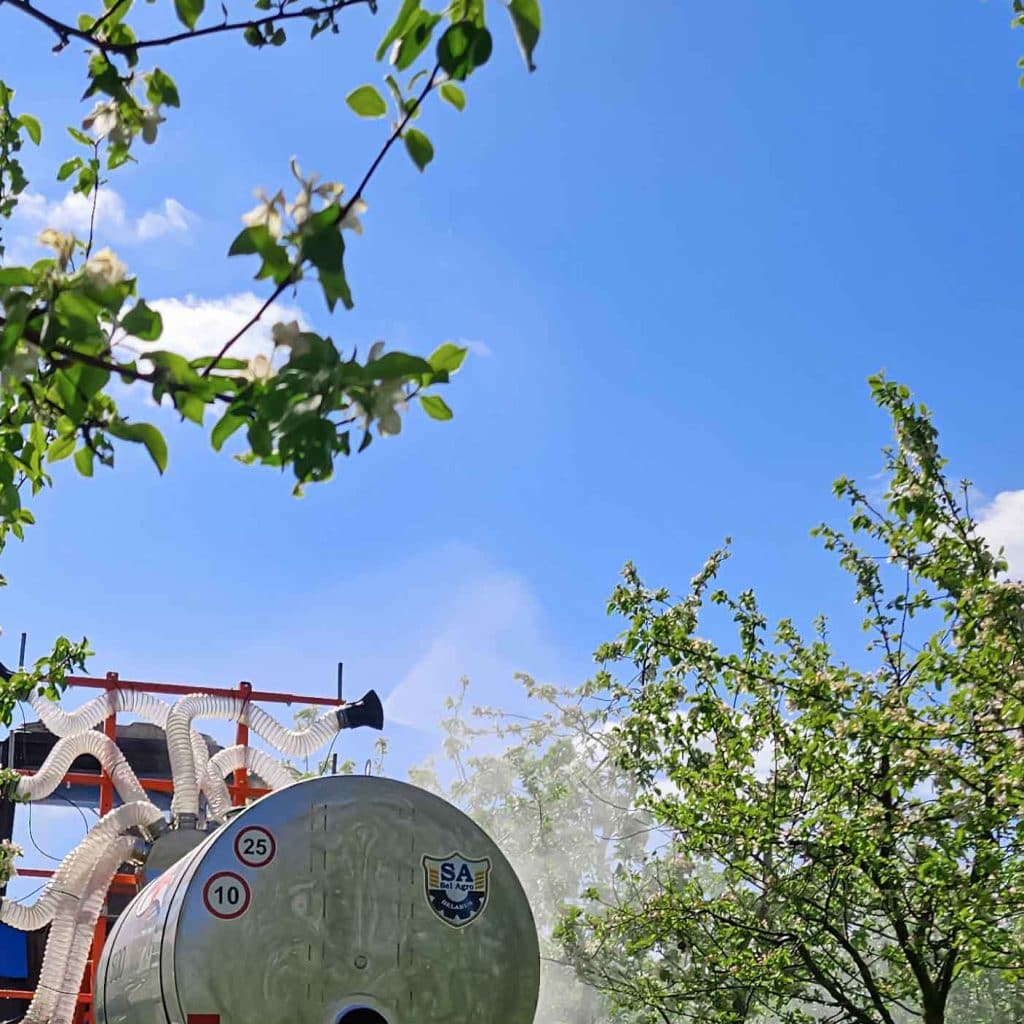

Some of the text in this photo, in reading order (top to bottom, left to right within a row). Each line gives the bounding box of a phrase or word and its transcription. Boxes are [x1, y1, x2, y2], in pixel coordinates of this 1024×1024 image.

[243, 838, 267, 855] 25
[441, 863, 474, 882] SA
[214, 886, 239, 905] 10
[455, 883, 473, 891] Agro
